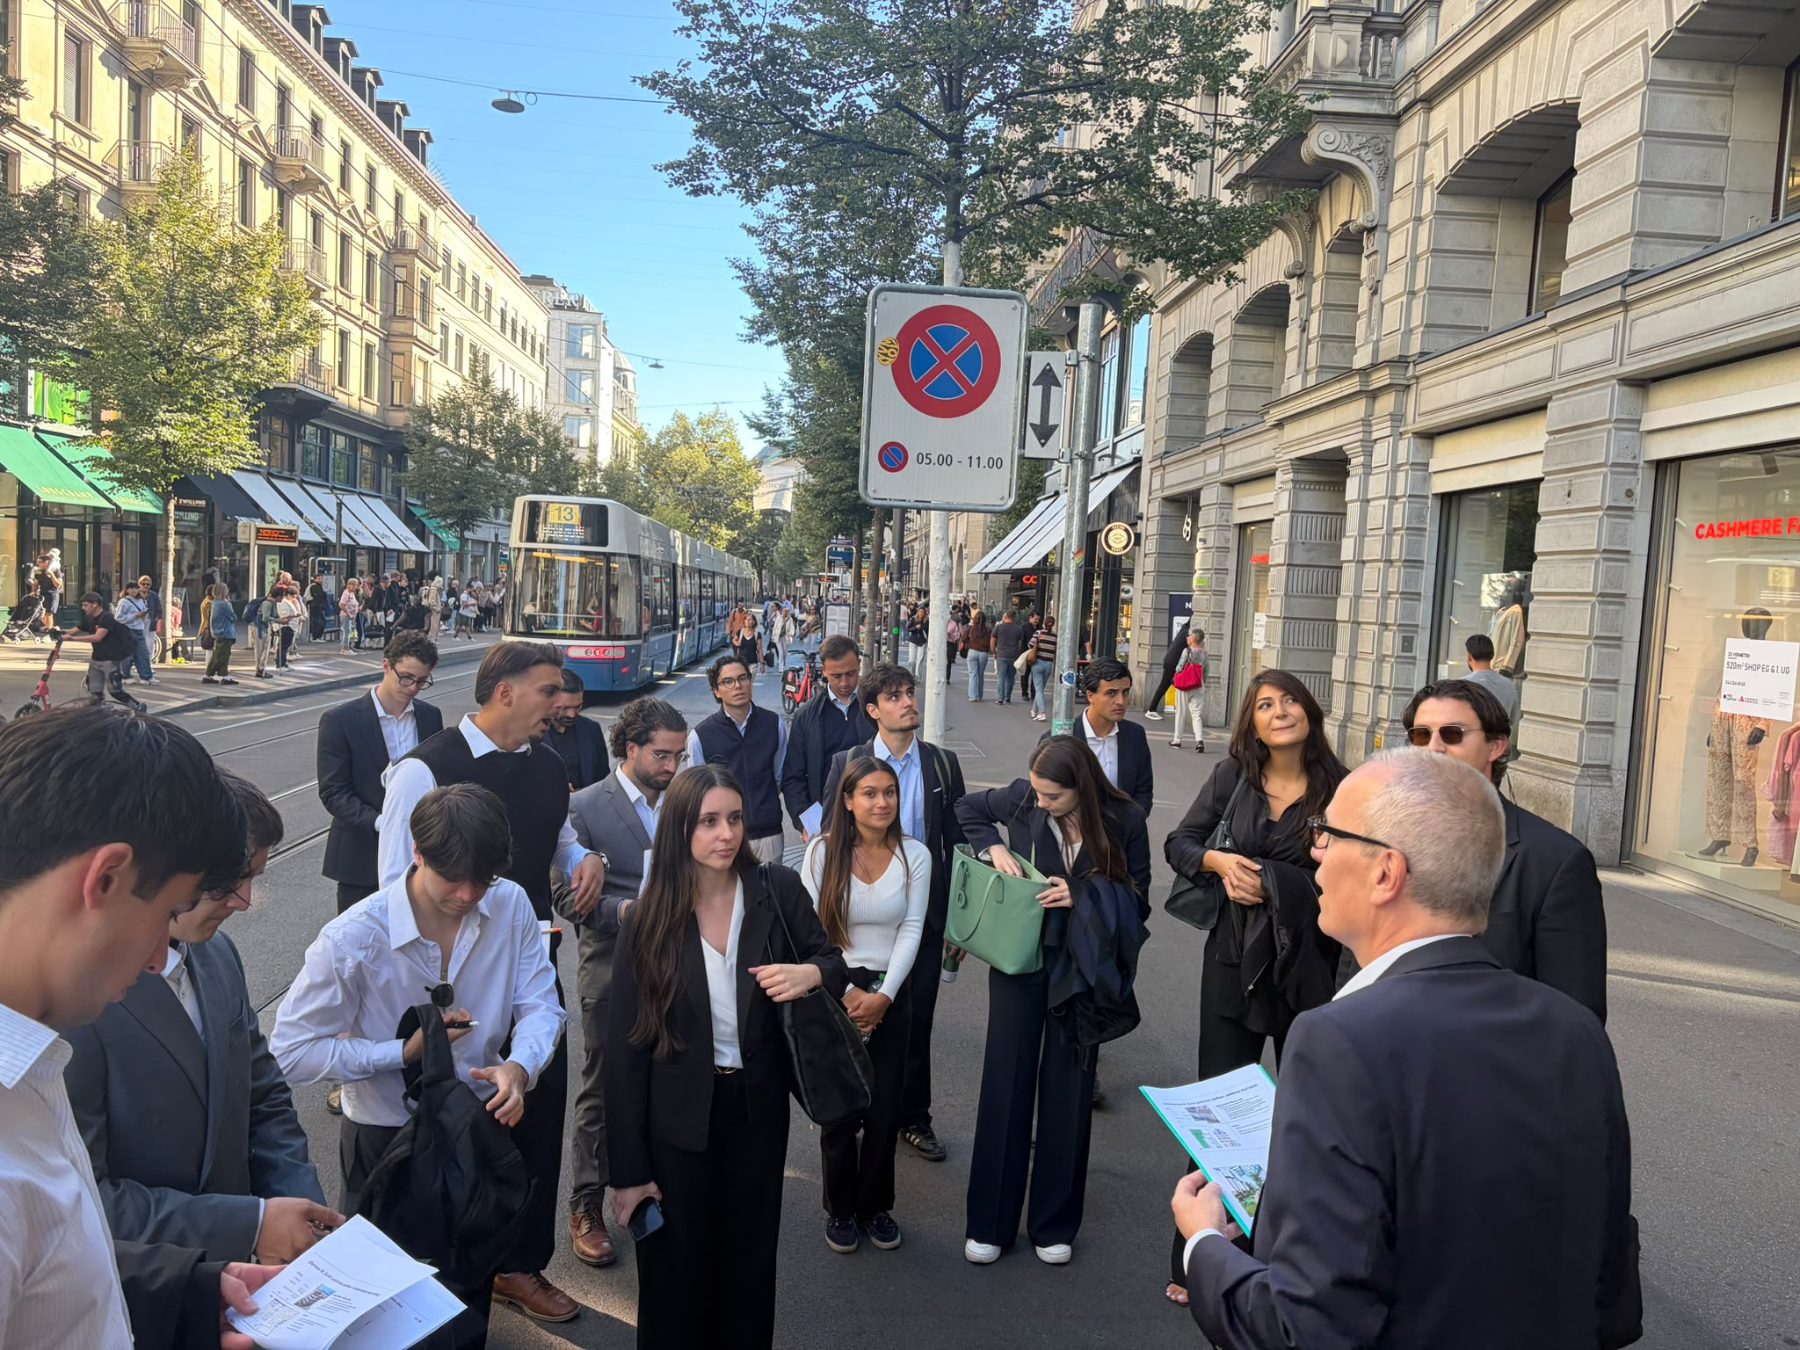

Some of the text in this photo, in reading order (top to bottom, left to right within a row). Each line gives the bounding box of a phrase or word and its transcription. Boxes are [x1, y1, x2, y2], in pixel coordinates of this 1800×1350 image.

[916, 452, 953, 467] 05.00
[967, 455, 1004, 469] 11.00
[557, 506, 574, 521] 13
[1695, 518, 1783, 540] CASHMERE
[1745, 662, 1761, 672] SHOP
[1781, 666, 1790, 675] UG
